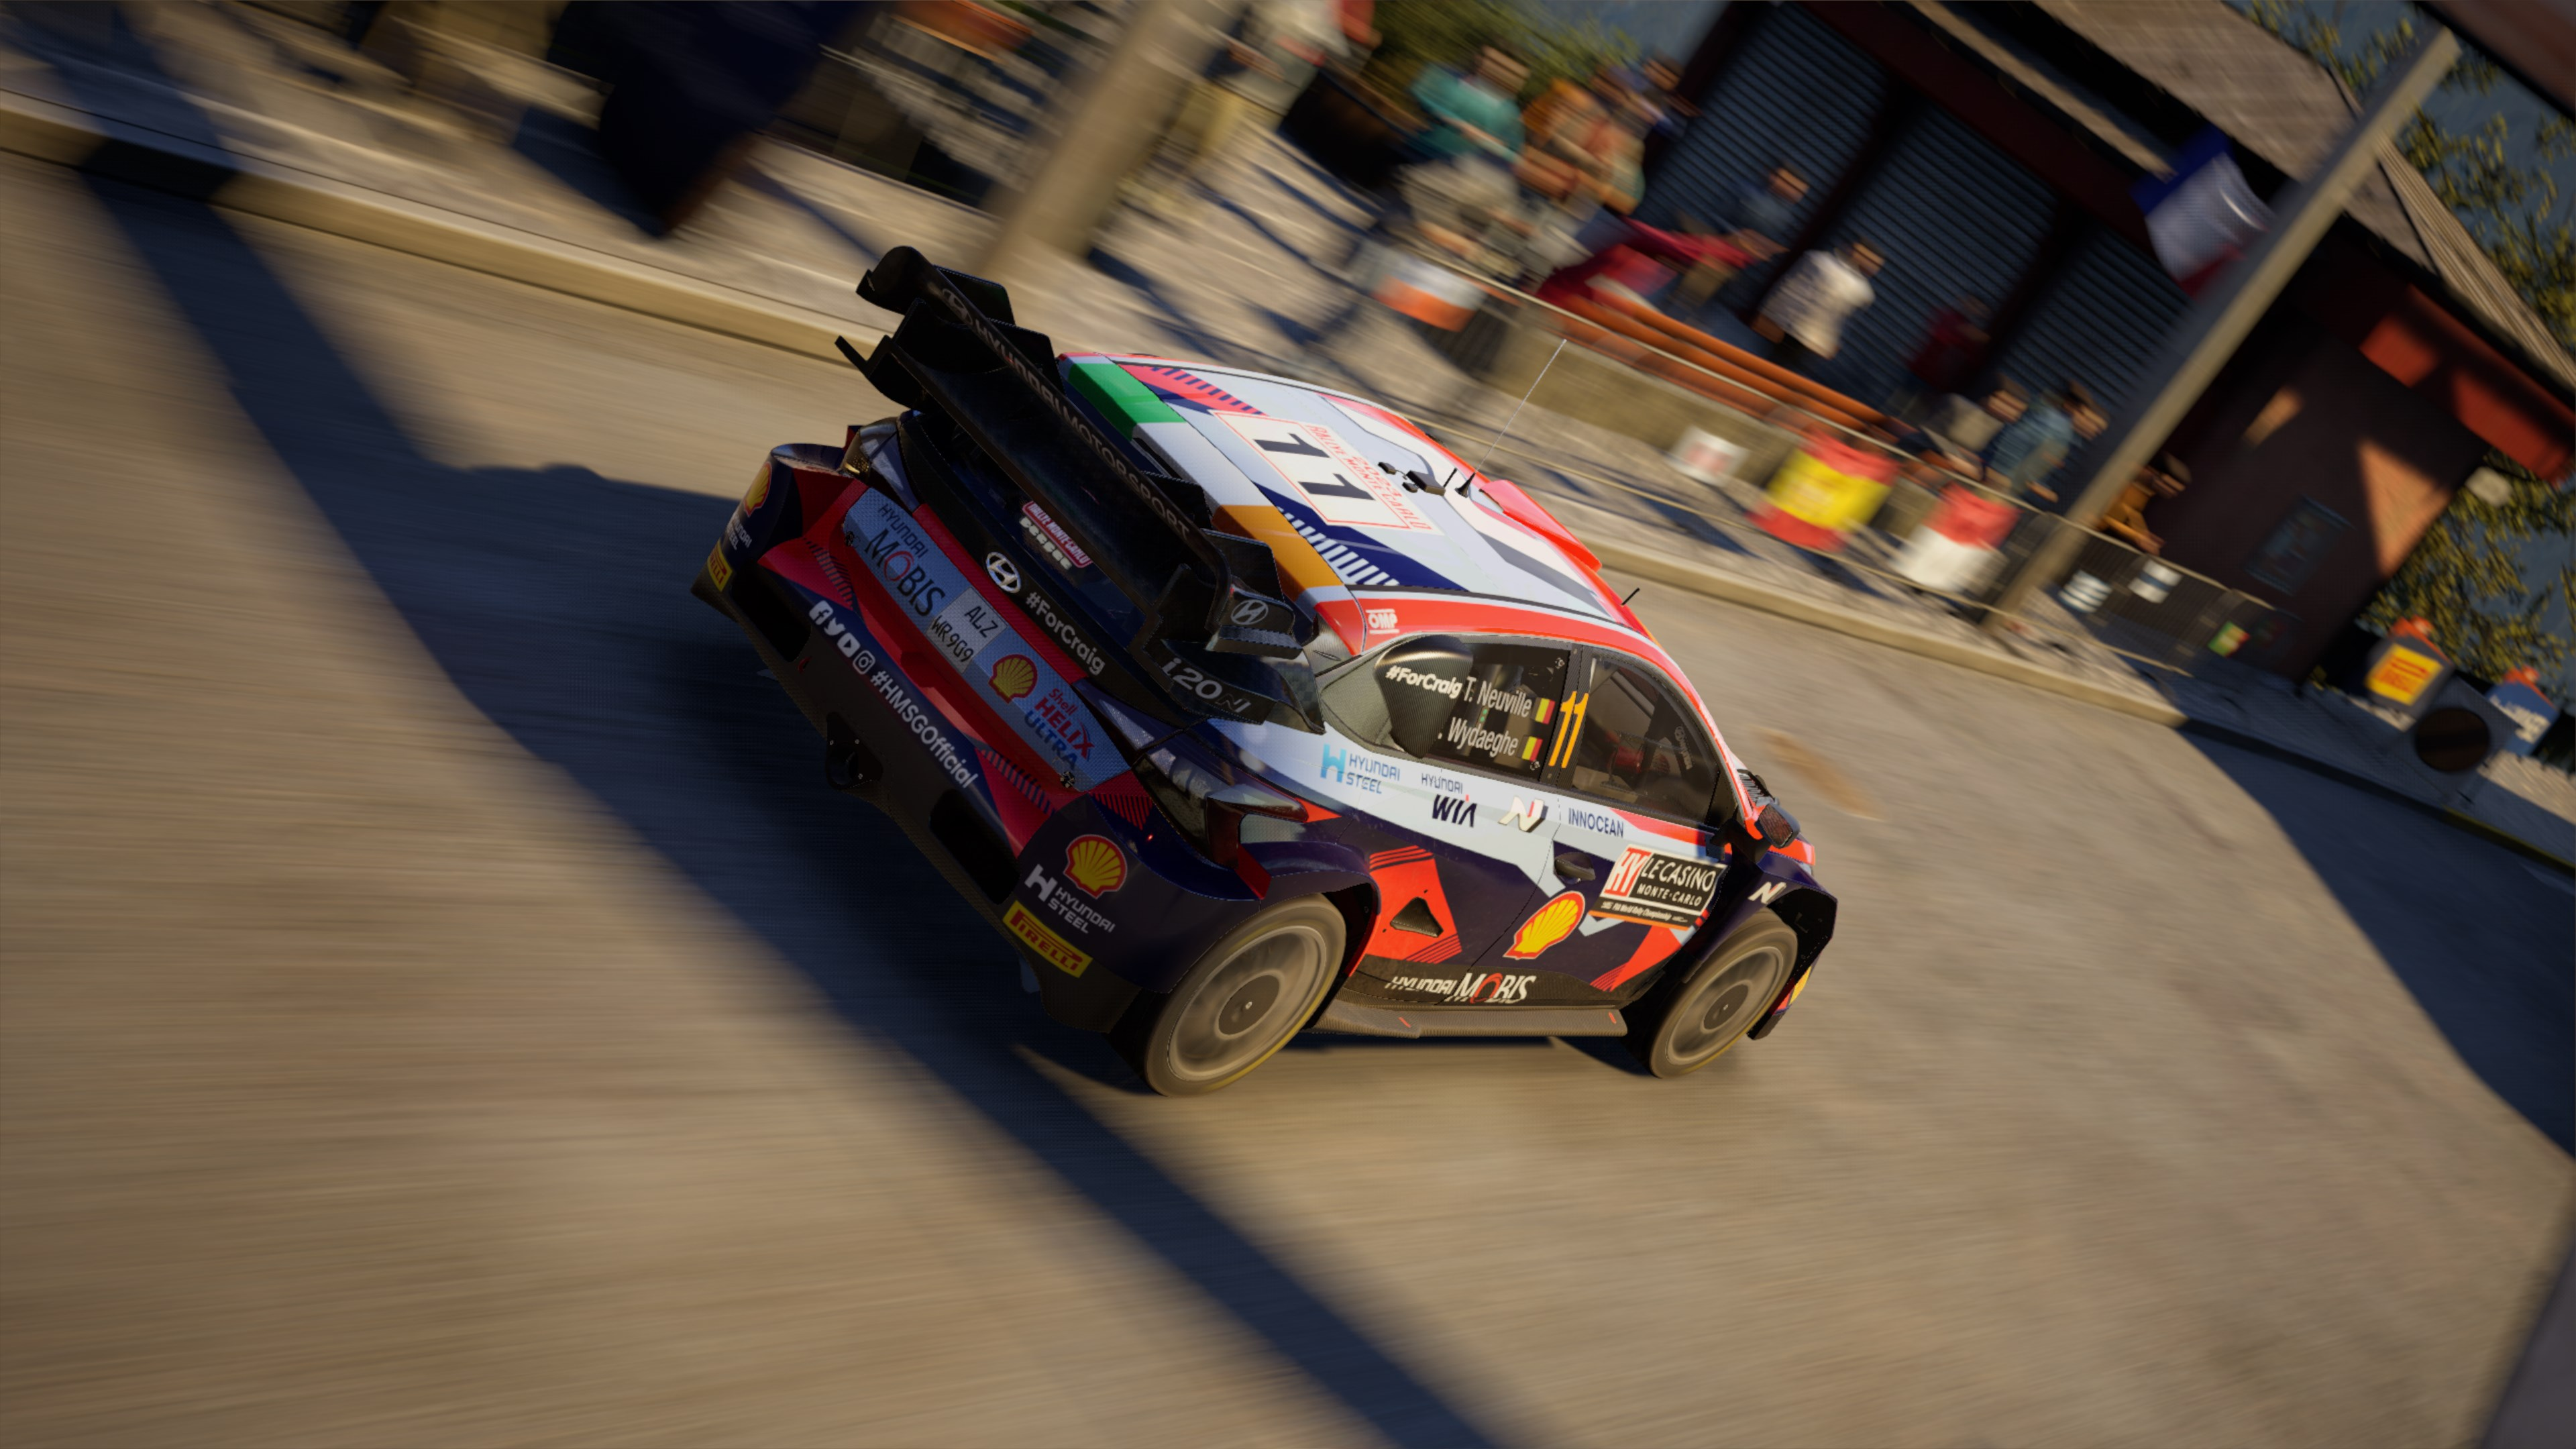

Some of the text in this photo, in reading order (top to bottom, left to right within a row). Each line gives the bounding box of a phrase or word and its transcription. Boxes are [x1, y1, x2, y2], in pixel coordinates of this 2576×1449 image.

[1252, 432, 1377, 501] 11
[878, 504, 929, 559] HYUNDAI
[864, 529, 946, 616] MOBIS
[931, 615, 953, 642] WR
[965, 606, 999, 638] ALZ
[1025, 592, 1106, 676] #ForCraig
[1368, 613, 1398, 629] OMP
[1386, 665, 1462, 699] #ForCraig
[1463, 676, 1533, 718] T. Neuville
[1049, 688, 1078, 716] Shell
[870, 669, 978, 789] #HMSGOfficial
[1024, 710, 1077, 770] ULTRA
[1034, 697, 1095, 759] HELIX
[1447, 717, 1519, 757] Wydaeghe
[1548, 690, 1589, 769] 11
[1346, 772, 1382, 794] STEEL
[1349, 753, 1400, 781] HYUNDAI
[1421, 773, 1463, 794] HYUNDAI
[1568, 808, 1624, 838] INNOCEAN
[1640, 857, 1717, 892] LE CASINO
[1047, 898, 1089, 934] STEEL
[1055, 886, 1116, 933] HYUNDAI
[1010, 910, 1083, 971] PIRELLI
[1385, 972, 1537, 1004] HYUNDAI MOBIS
